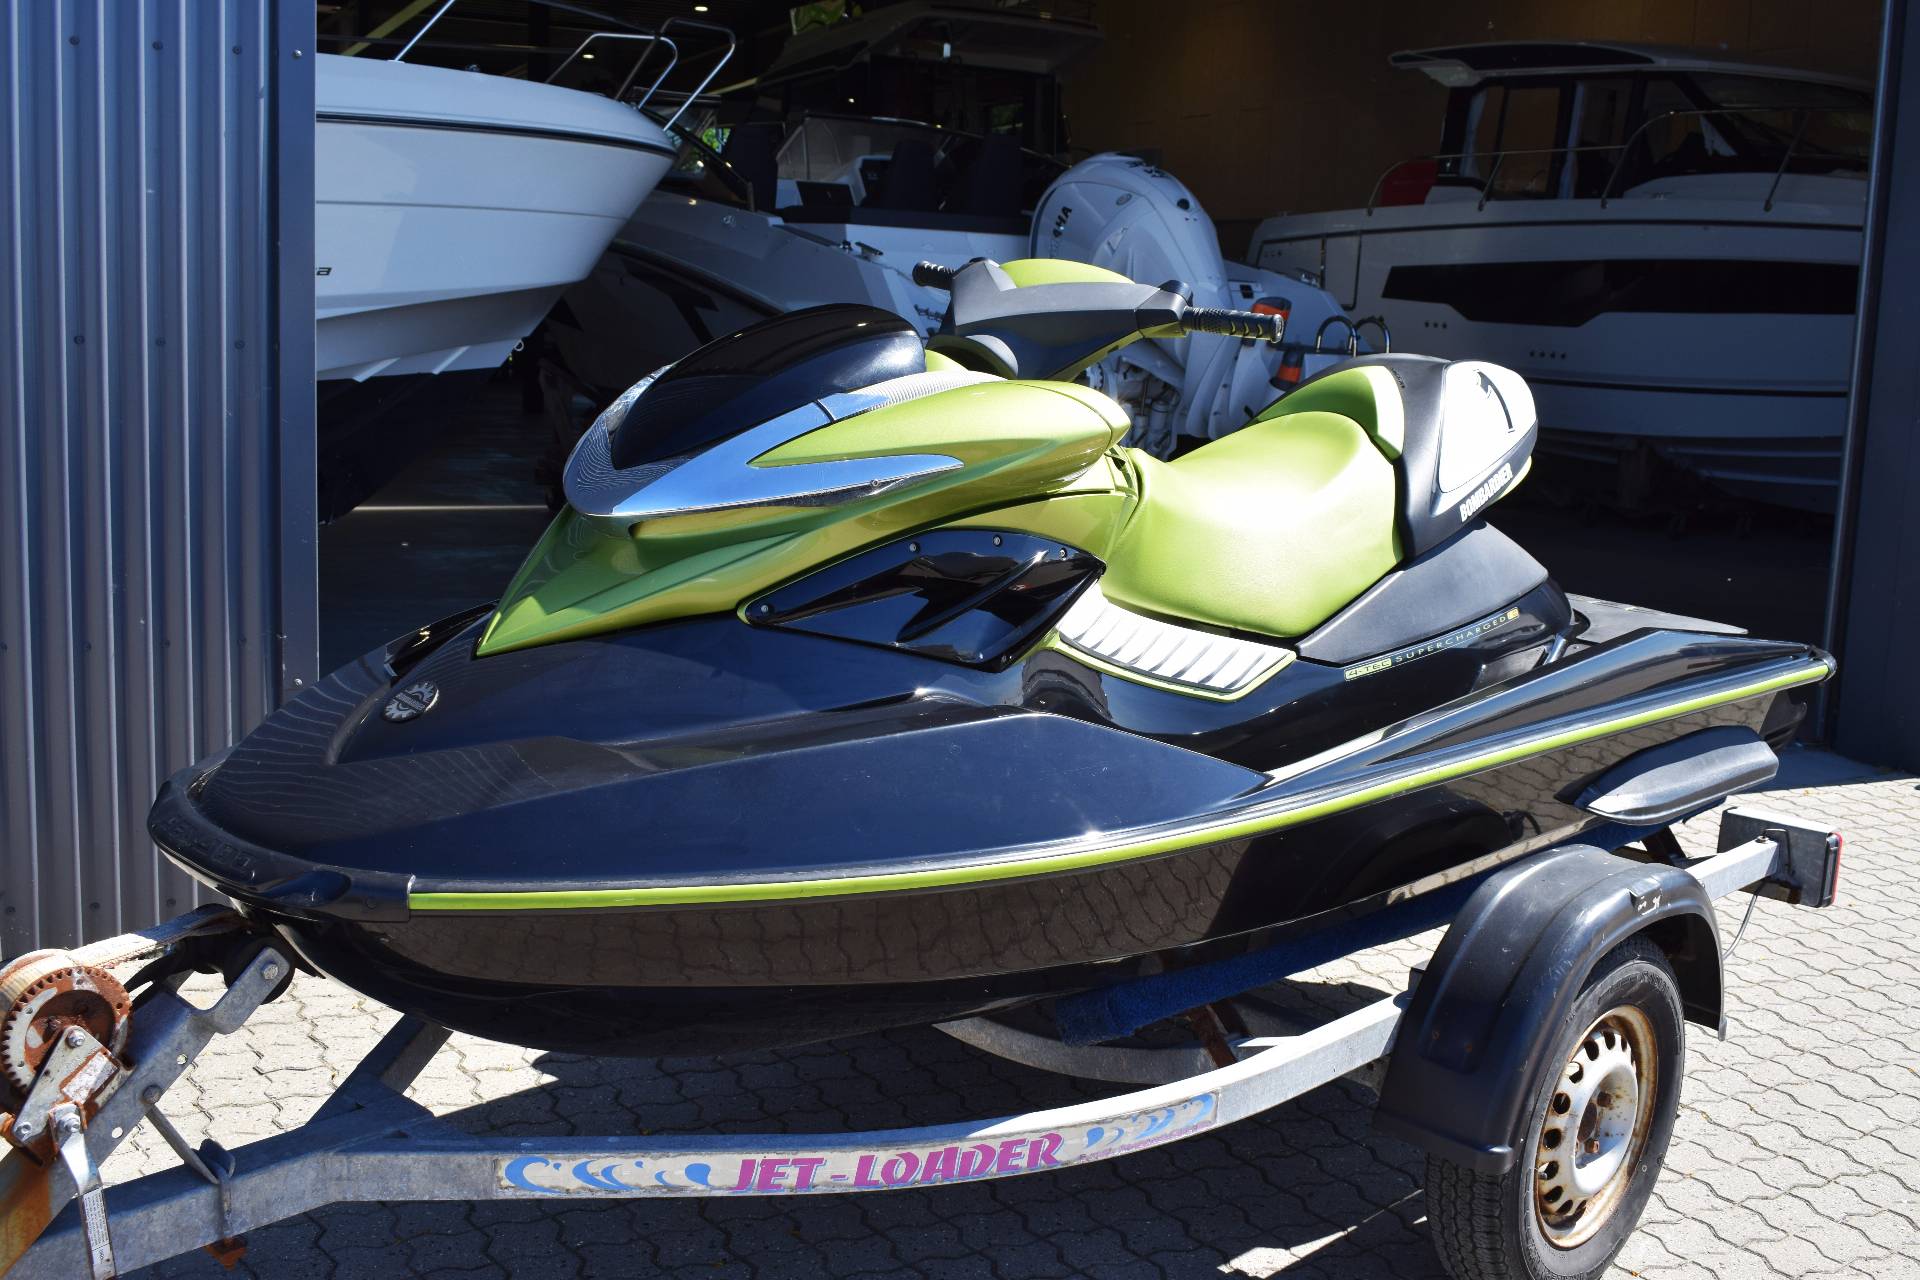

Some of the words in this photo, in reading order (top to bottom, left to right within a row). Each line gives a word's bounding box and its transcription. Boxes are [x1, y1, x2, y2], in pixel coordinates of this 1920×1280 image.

[1459, 462, 1513, 523] BOMBARDIER
[1347, 658, 1391, 677] 4-TEC
[1395, 616, 1506, 663] SUPERCHARGED
